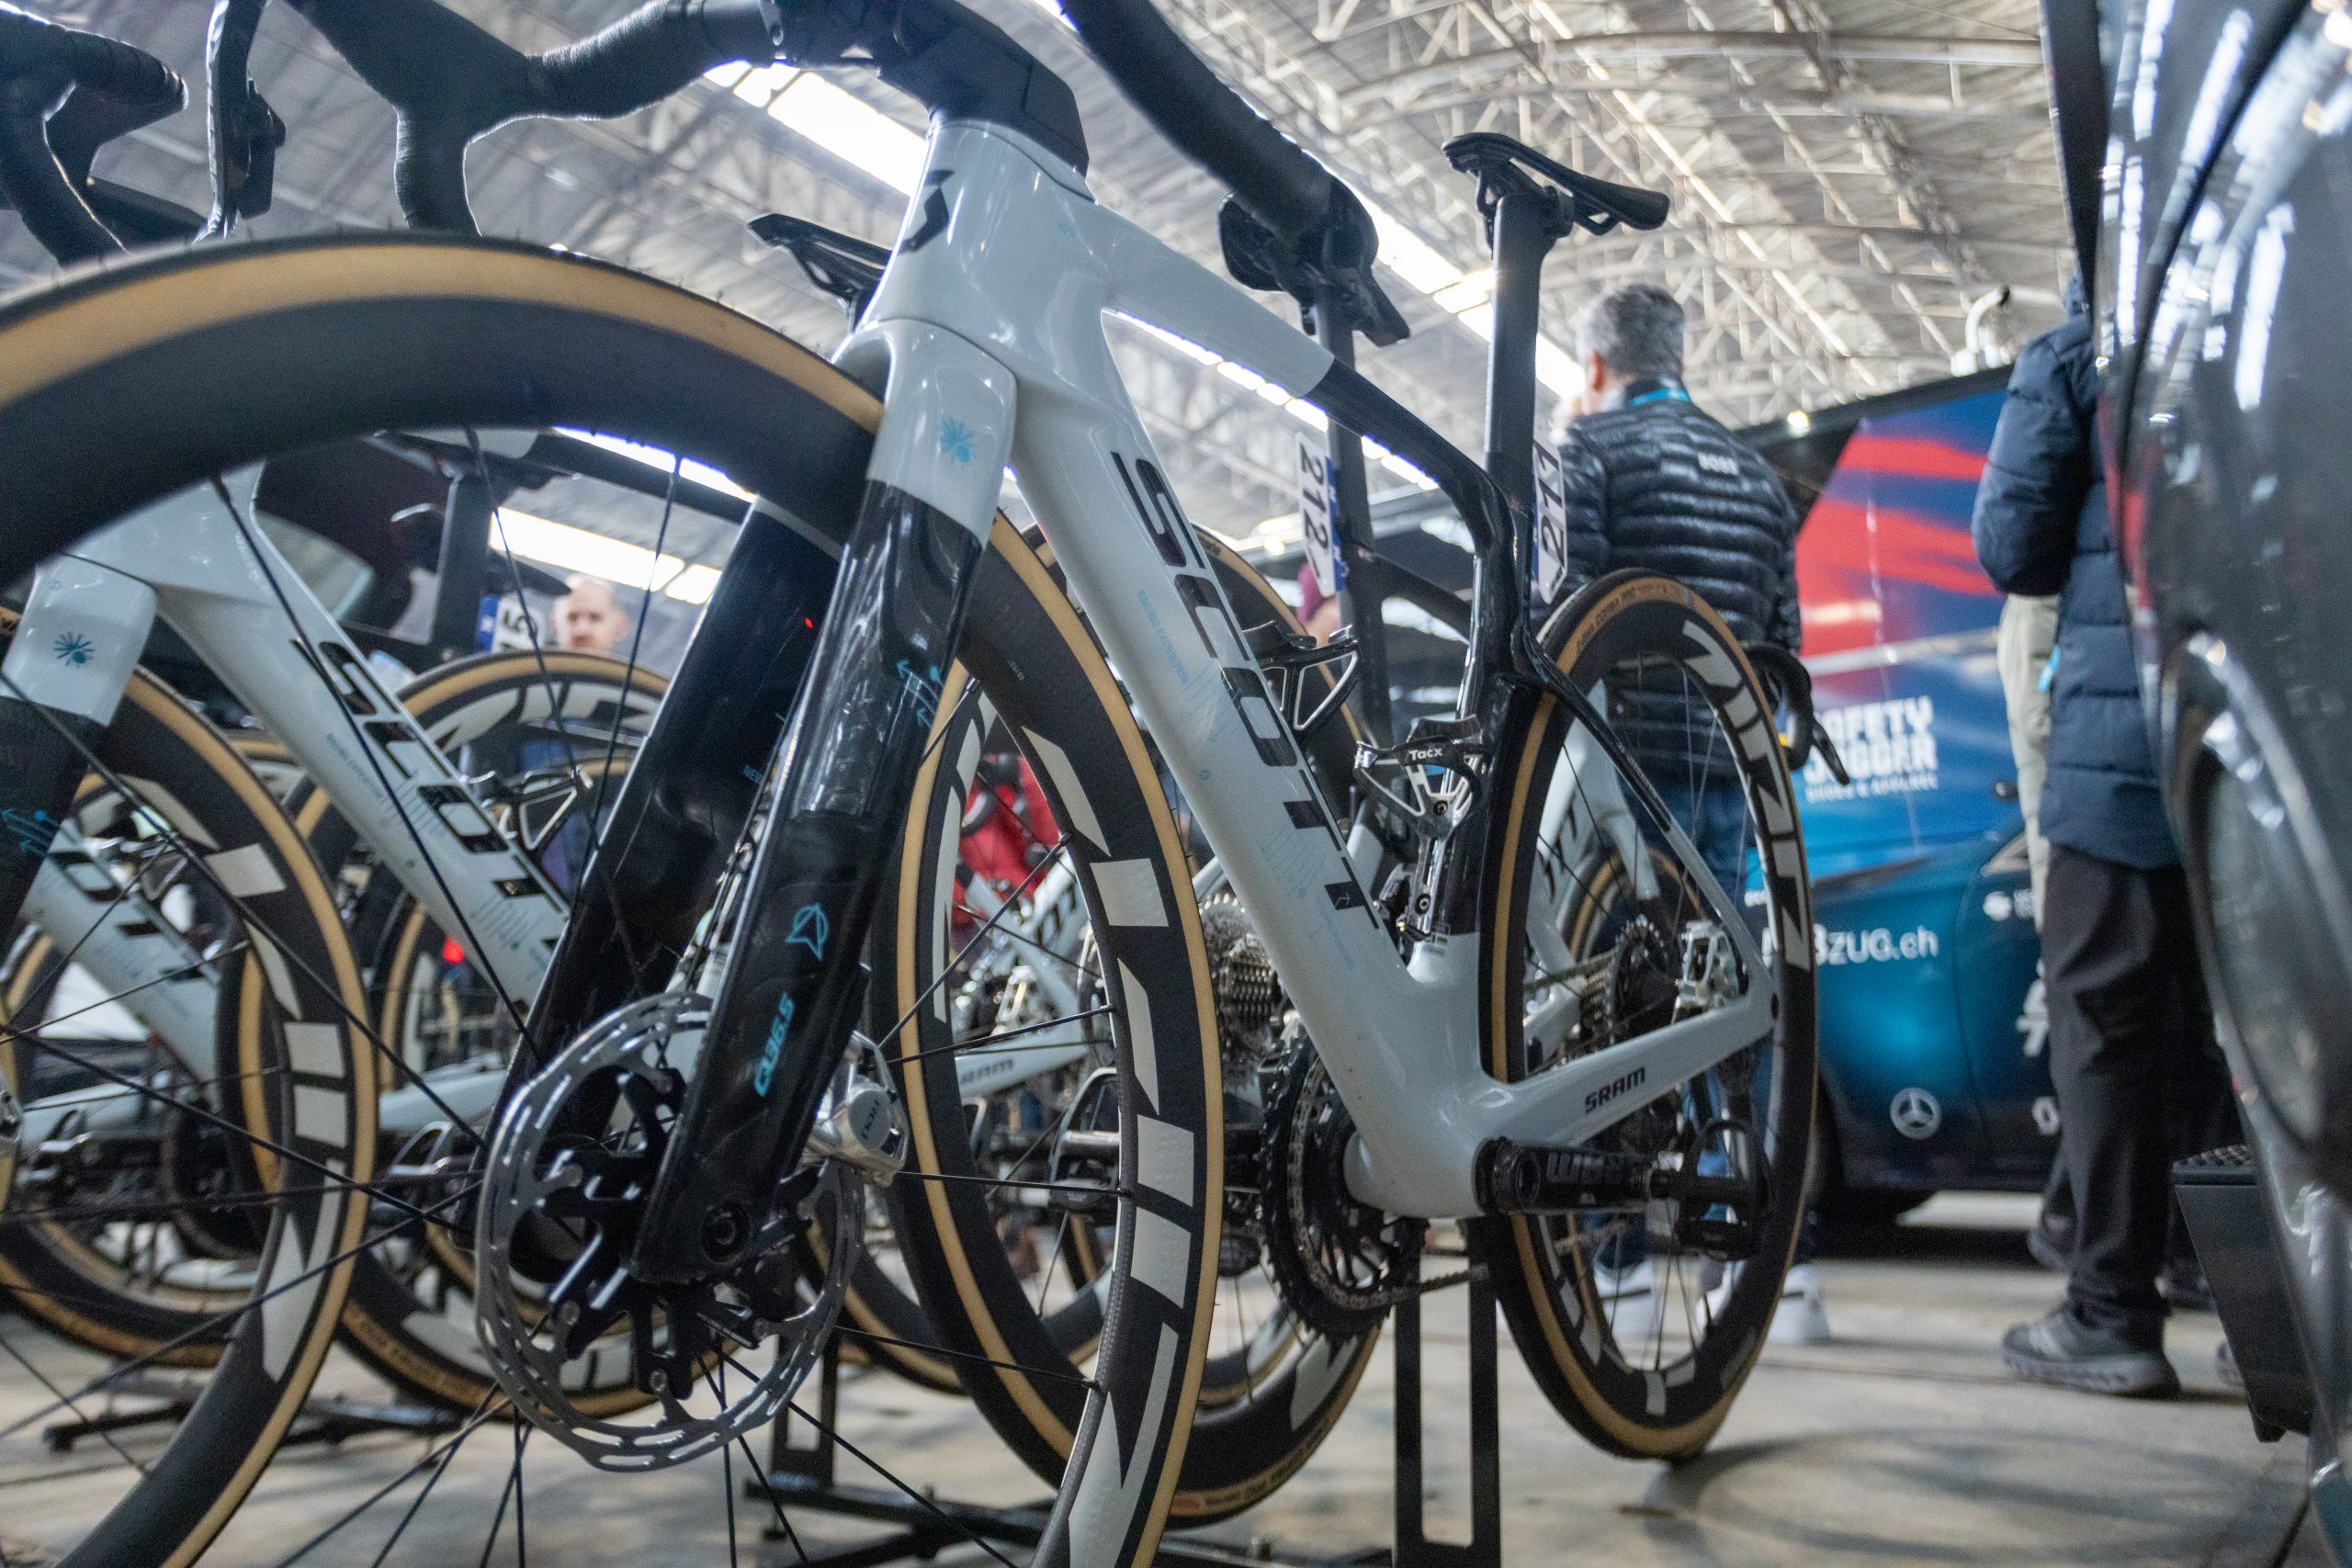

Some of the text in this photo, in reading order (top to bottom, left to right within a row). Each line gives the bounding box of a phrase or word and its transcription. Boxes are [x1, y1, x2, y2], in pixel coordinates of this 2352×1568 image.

[1301, 444, 1329, 549] 212
[1111, 450, 1380, 931] SCOTT
[1815, 695, 1934, 746] AFETY
[1408, 748, 1443, 761] Tacx
[1585, 1066, 1646, 1114] SRAM
